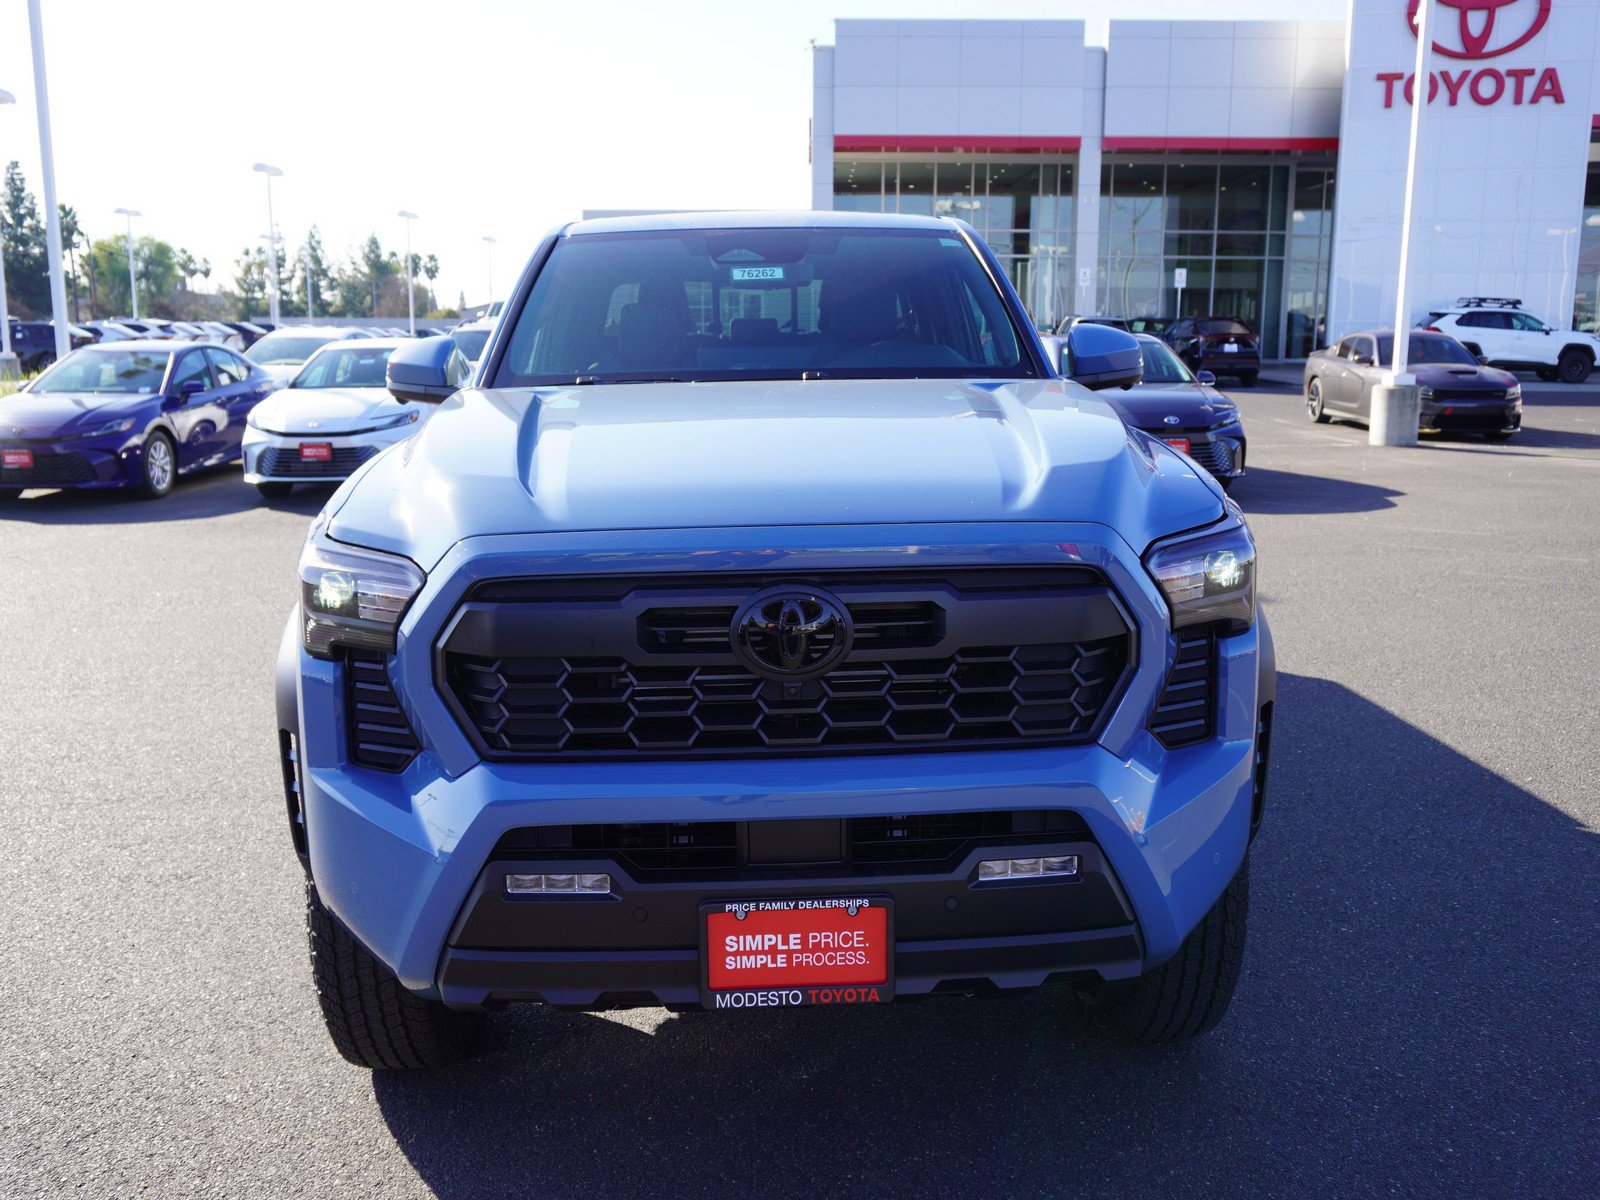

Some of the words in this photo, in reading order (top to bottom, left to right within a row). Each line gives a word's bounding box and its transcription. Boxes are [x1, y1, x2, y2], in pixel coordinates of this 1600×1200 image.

[1376, 67, 1565, 109] TOYOTA
[740, 268, 776, 278] 76262
[725, 902, 756, 912] PRICE
[759, 901, 796, 911] FAMILY
[798, 899, 870, 909] DEALERSHIPS
[725, 933, 802, 952] SIMPLE
[808, 931, 870, 949] PRICE.
[725, 954, 787, 970] SIMPLE
[792, 951, 870, 967] PROCESS.
[716, 990, 802, 1009] MODESTO
[808, 987, 880, 1004] TOYOTA
